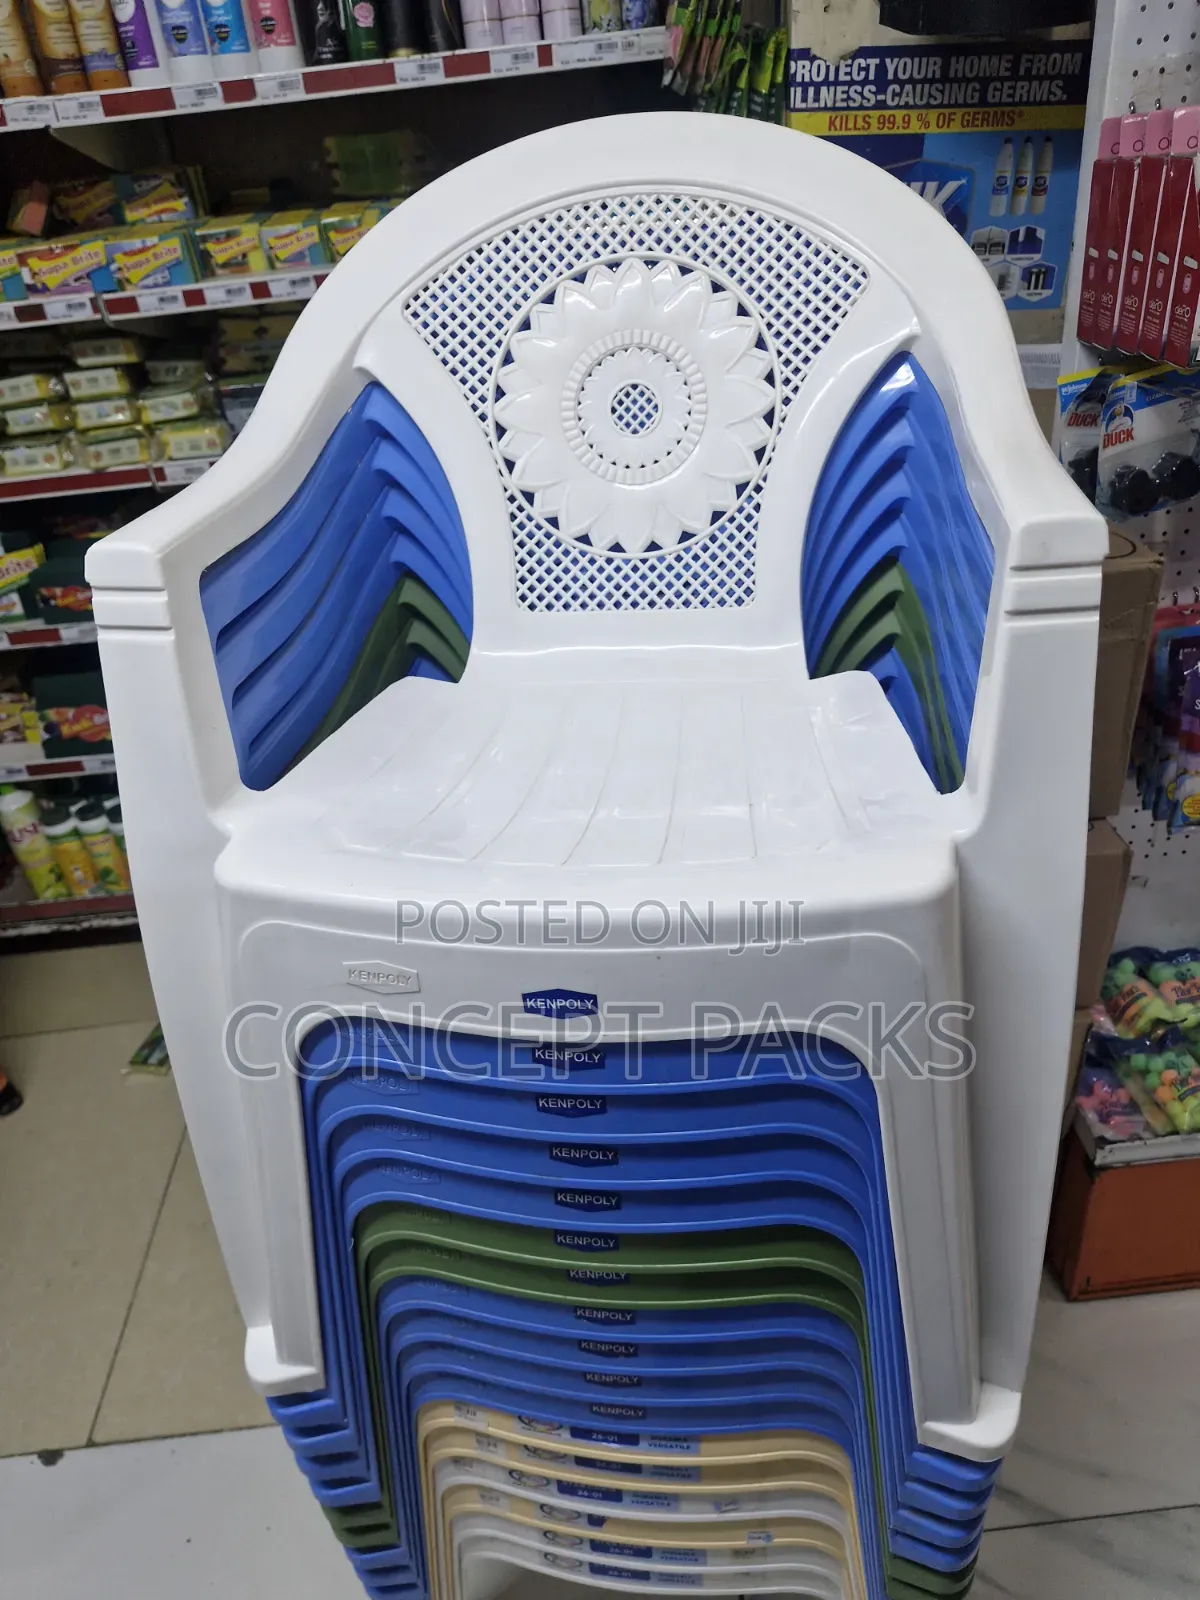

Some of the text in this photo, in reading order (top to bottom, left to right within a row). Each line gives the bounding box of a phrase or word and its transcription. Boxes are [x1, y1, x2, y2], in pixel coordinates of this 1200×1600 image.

[789, 53, 1082, 82] PROTECT YOUR HOME FROM
[790, 83, 980, 109] ILLNESS-CAUSING
[986, 80, 1067, 103] GERMS.
[828, 114, 871, 131] KILLS
[877, 114, 911, 131] 99.9
[916, 112, 930, 130] %
[936, 112, 957, 129] OF
[1067, 411, 1099, 427] DUCK
[1102, 427, 1135, 449] DUCK
[348, 968, 412, 986] KENPOLY
[526, 998, 594, 1010] KENPOLY
[535, 1048, 601, 1063] KENPOLY
[538, 1098, 602, 1109] KENPOLY
[552, 1147, 614, 1160] KENPOLY
[557, 1192, 618, 1206] KENPOLY
[557, 1234, 616, 1248] KENPOLY
[569, 1269, 627, 1280] KENPOLY
[576, 1308, 632, 1321] KENPOLY
[580, 1341, 635, 1353] KENPOLY
[585, 1373, 639, 1384] KENPOLY
[592, 1404, 644, 1417] KENPOLY
